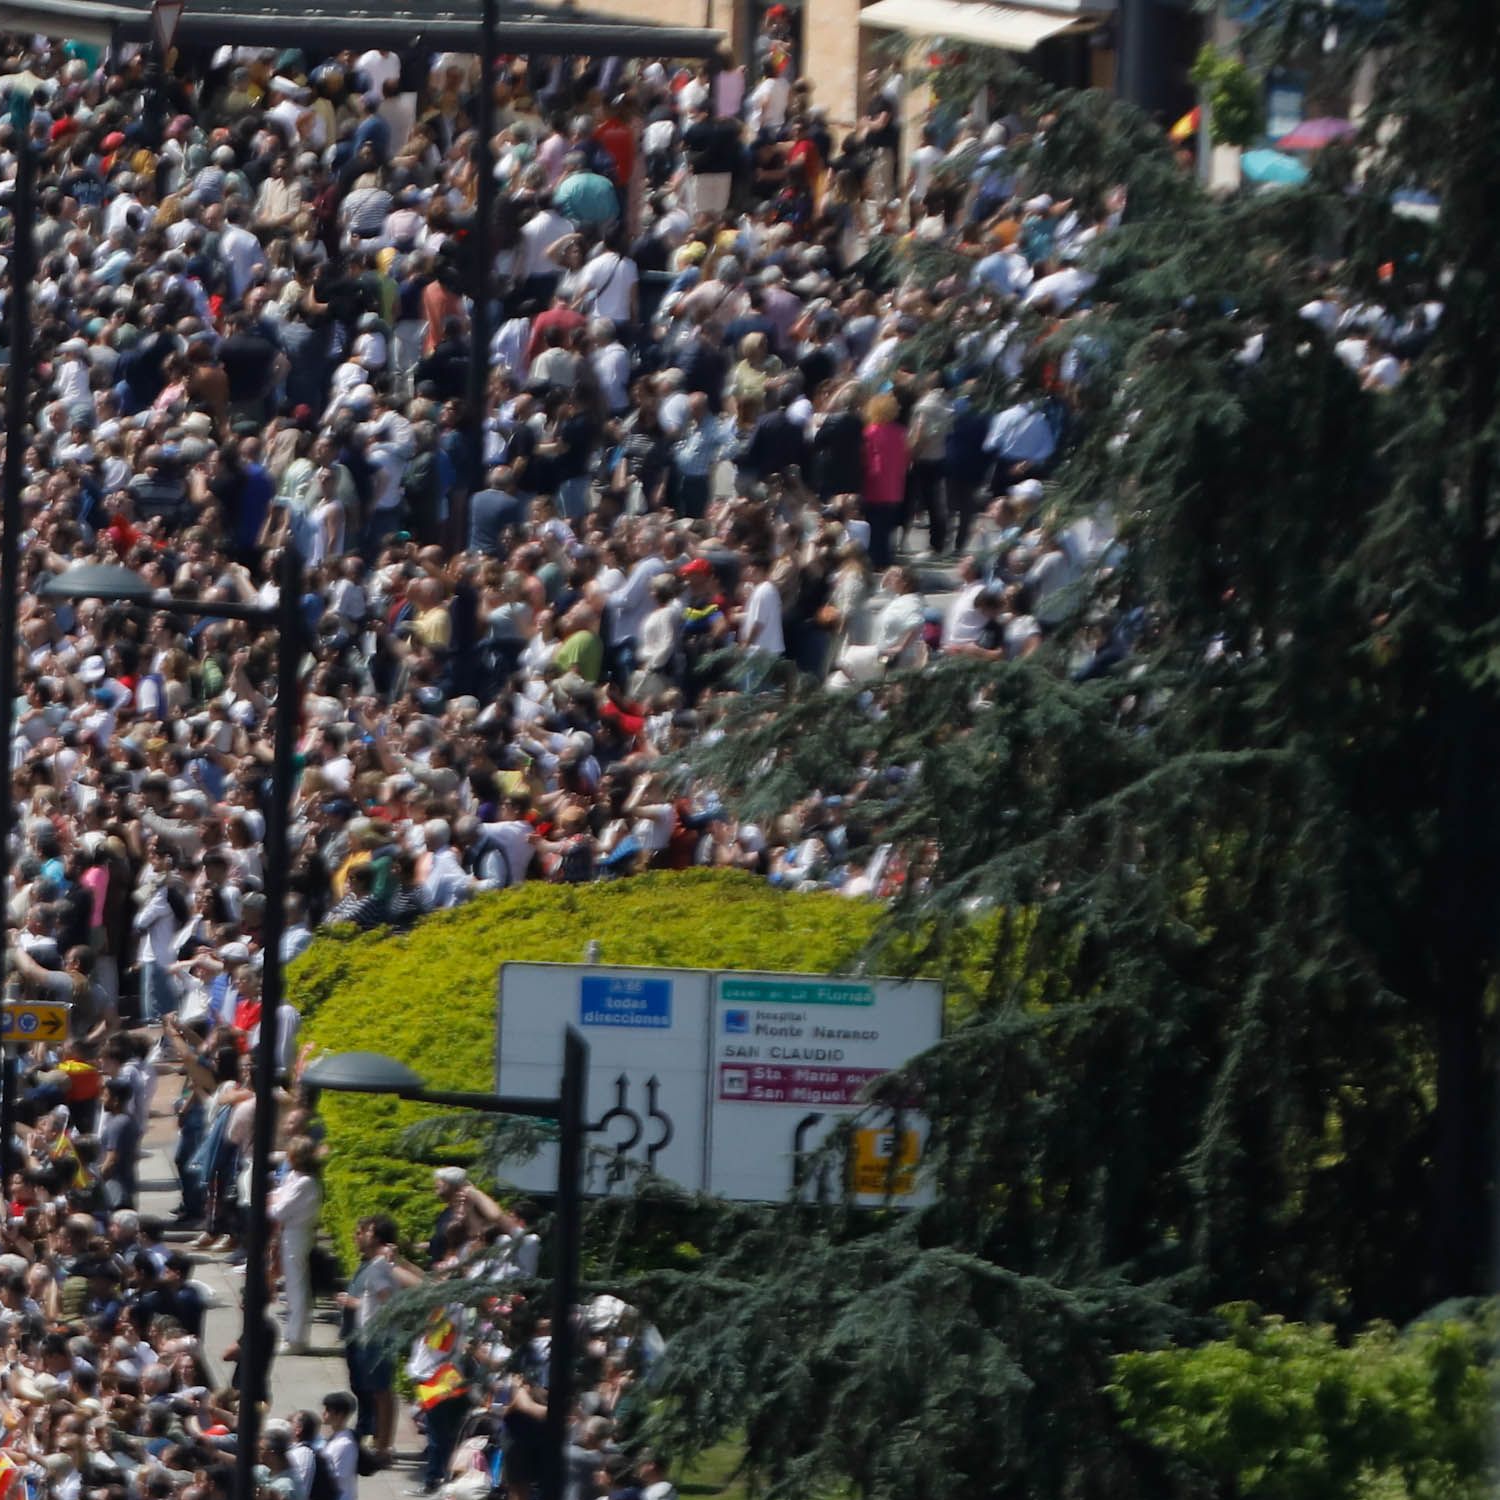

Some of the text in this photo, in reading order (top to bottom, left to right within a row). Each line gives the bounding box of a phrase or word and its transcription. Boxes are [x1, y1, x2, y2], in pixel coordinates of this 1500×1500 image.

[817, 987, 875, 1001] Florida
[606, 996, 648, 1009] todas
[583, 1010, 669, 1025] direcciones
[755, 1009, 807, 1023] Hospital
[755, 1024, 880, 1041] Monte Naranco
[725, 1046, 845, 1061] SAN CLAUDIO
[752, 1086, 847, 1102] San Miguel
